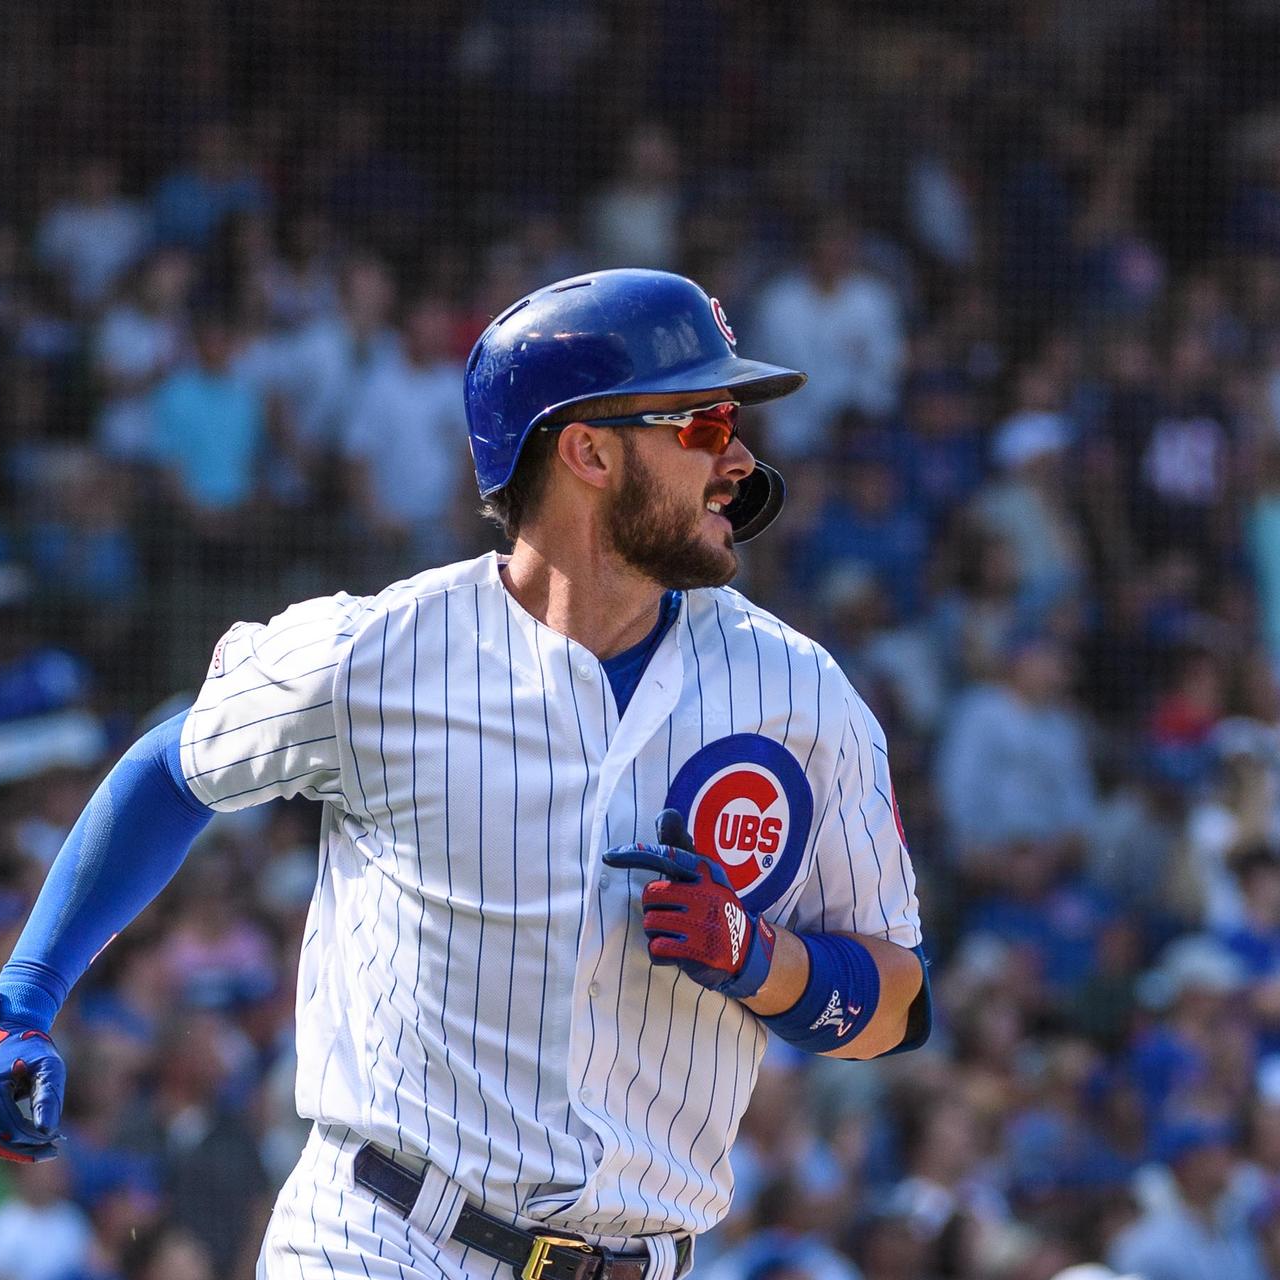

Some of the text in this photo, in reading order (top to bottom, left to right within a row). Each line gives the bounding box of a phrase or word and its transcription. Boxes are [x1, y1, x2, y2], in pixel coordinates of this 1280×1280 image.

[694, 769, 784, 891] CUBS
[724, 901, 740, 966] adidas
[809, 989, 839, 1030] adidas
